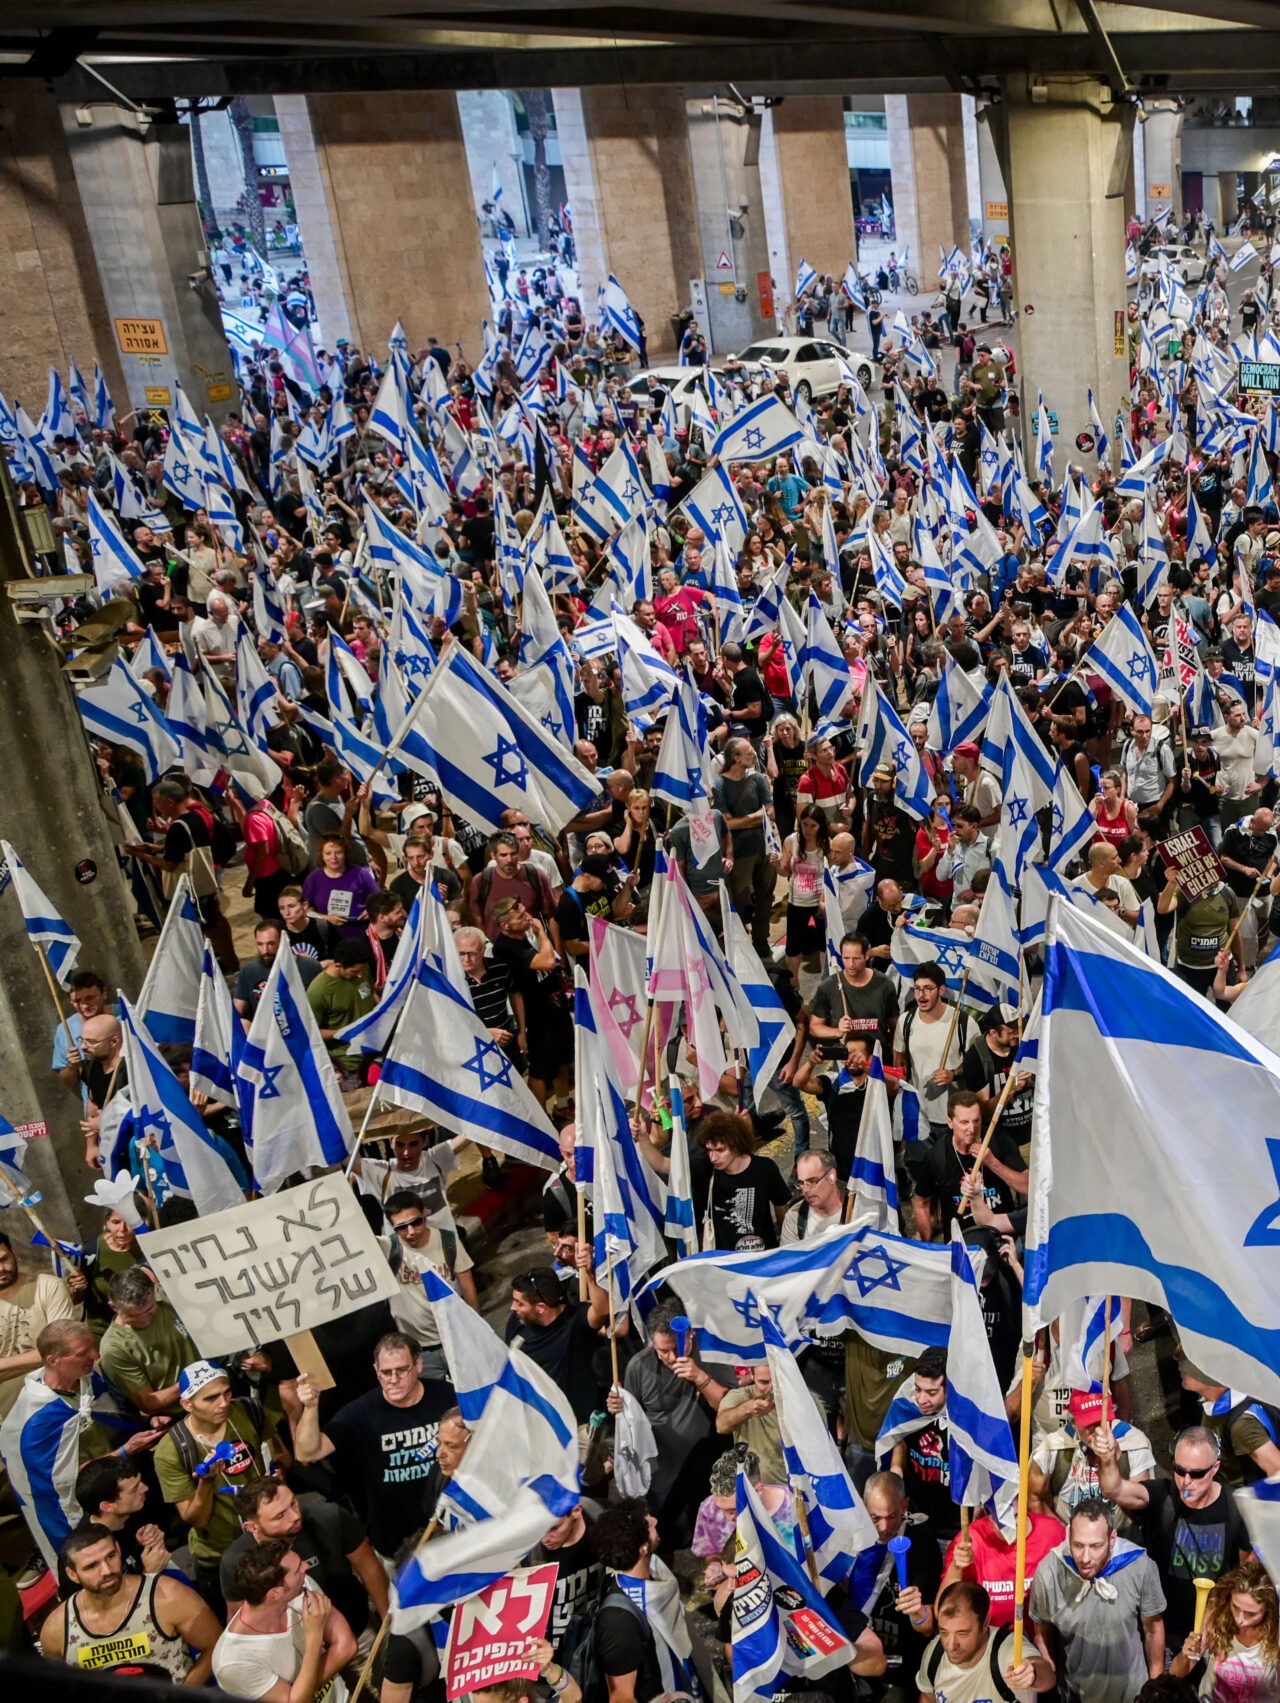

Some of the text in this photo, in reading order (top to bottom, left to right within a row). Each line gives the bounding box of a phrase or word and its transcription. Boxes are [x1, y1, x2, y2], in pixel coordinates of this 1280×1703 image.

[122, 322, 155, 335] עצירה
[125, 337, 160, 350] אסורה
[1241, 363, 1280, 376] DEMOCRACY
[1241, 374, 1280, 389] WILL WIN
[1163, 830, 1201, 858] ISRAEL
[1175, 848, 1202, 867] WILL
[1174, 852, 1218, 886] NEVER BE
[1186, 869, 1219, 897] GILEAD
[277, 1183, 341, 1243] לא
[151, 1225, 259, 1279] נחיה
[195, 1235, 365, 1305] במשטר
[233, 1267, 378, 1347] של לוין
[381, 1422, 439, 1452] אמנים
[458, 1574, 549, 1647] לא
[82, 1643, 146, 1670] חורבן וביזה
[91, 1637, 134, 1658] ממשלת
